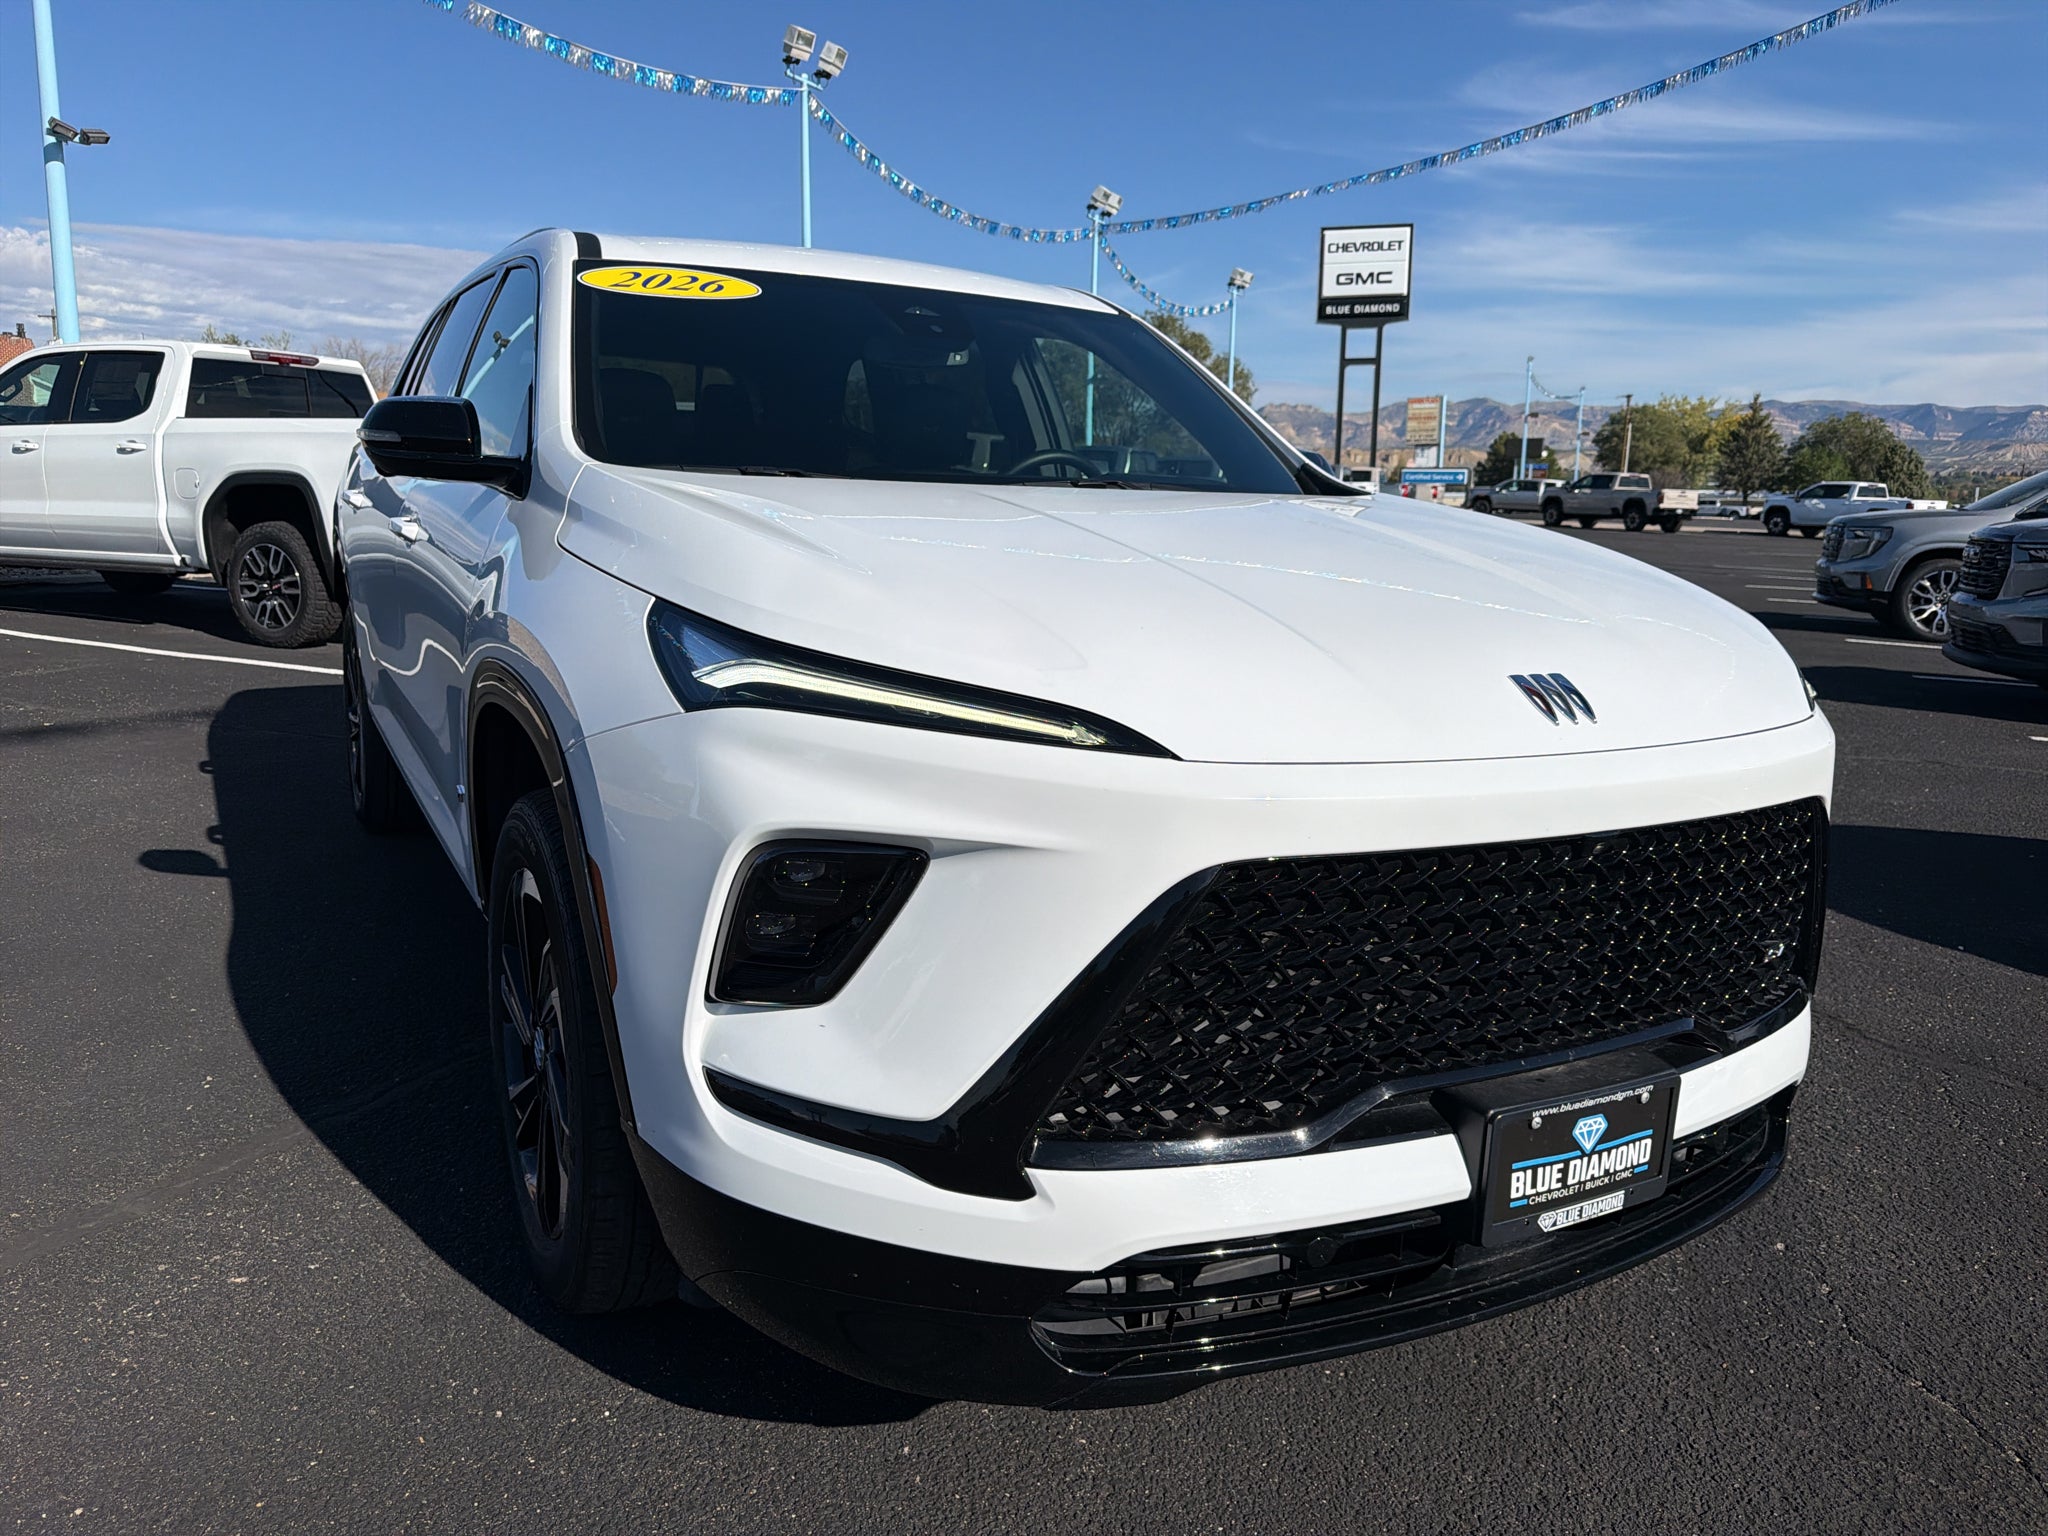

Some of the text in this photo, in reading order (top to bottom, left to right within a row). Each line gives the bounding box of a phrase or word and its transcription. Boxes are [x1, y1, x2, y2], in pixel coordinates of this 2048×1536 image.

[1327, 240, 1404, 254] CHEVROLET
[608, 271, 732, 294] 2026
[1336, 271, 1393, 286] GMC
[1325, 303, 1400, 315] BLUE DIAMOND
[1532, 1084, 1654, 1118] www.bluediamondgm.com
[1510, 1138, 1653, 1199] BLUE DIAMOND
[1528, 1169, 1634, 1205] CHEVROLET BUICK GMC
[1556, 1207, 1581, 1225] BLUE
[1582, 1194, 1625, 1218] DIAMOND
